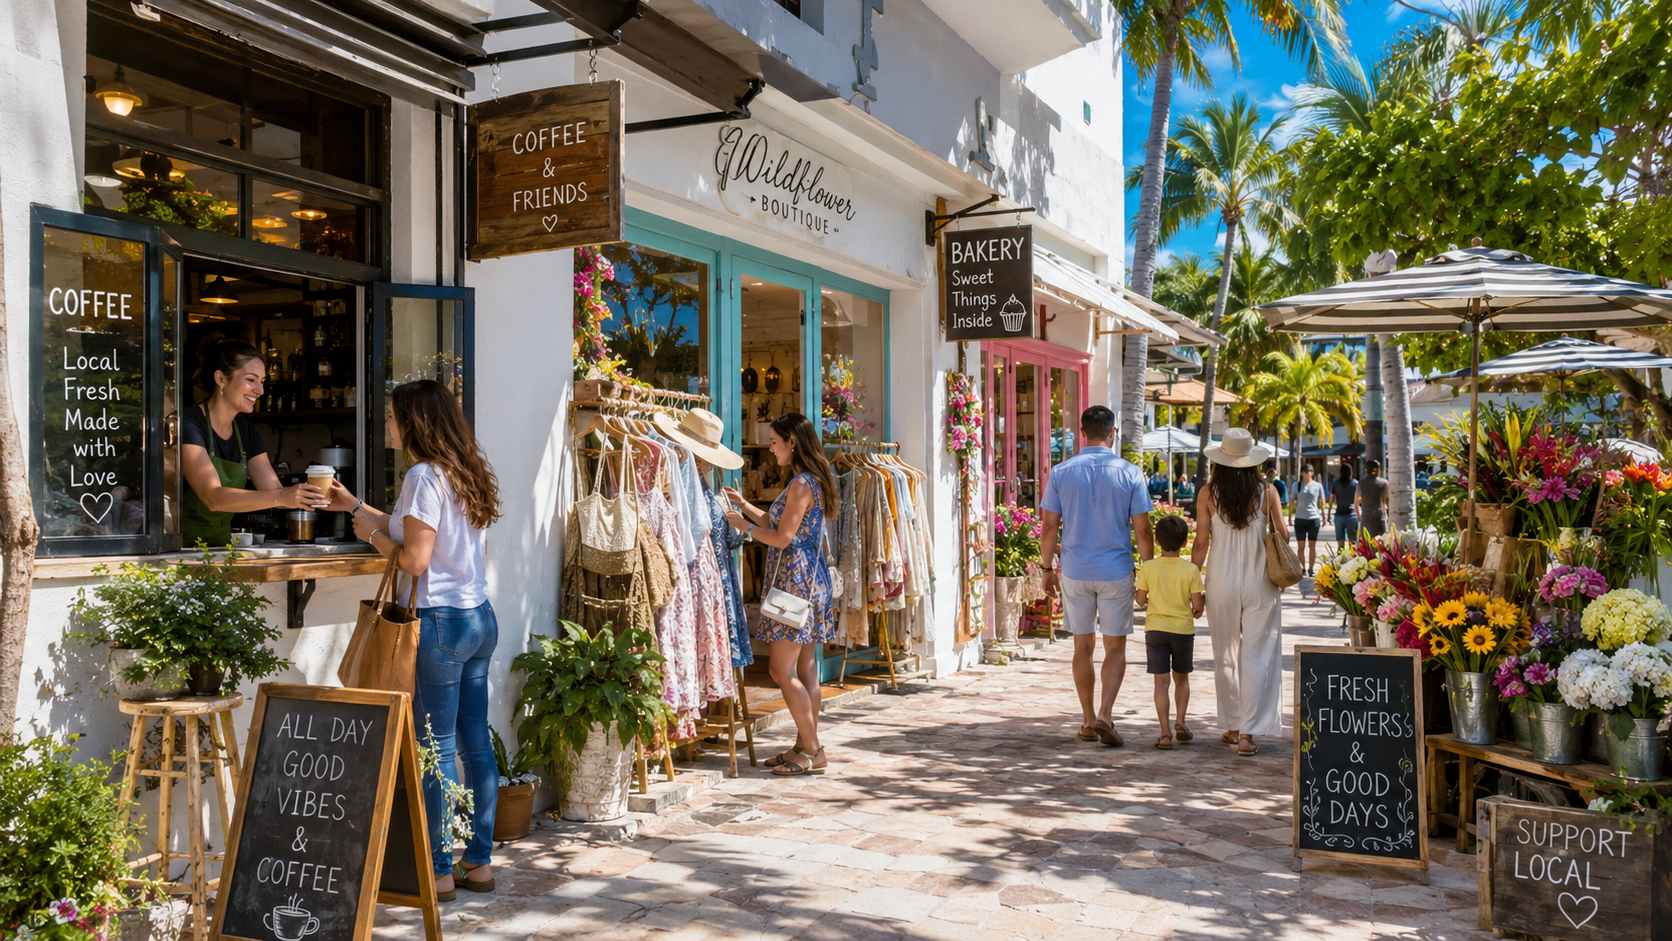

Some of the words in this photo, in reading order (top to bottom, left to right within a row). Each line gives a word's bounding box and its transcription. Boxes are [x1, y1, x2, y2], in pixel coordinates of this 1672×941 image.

[513, 121, 587, 155] COFFEE
[543, 158, 555, 177] &
[715, 127, 856, 221] Wildflower
[514, 182, 587, 211] FRIENDS
[762, 195, 829, 235] BOUTIQUE
[952, 237, 1024, 263] BAKERY
[953, 269, 993, 285] Sweet
[49, 287, 132, 319] COFFEE
[953, 291, 996, 311] Things
[953, 312, 992, 328] Inside
[63, 346, 120, 371] Local
[65, 378, 119, 400] Fresh
[66, 408, 119, 430] Made
[73, 437, 116, 457] with
[71, 465, 117, 486] Love
[1328, 675, 1388, 703] FRESH
[277, 713, 317, 740] ALL
[331, 717, 373, 745] DAY
[1319, 708, 1402, 737] FLOWERS
[284, 751, 344, 780] GOOD
[1350, 742, 1364, 763] &
[1326, 769, 1389, 796] GOOD
[277, 787, 346, 820] VIBES
[1331, 800, 1388, 828] DAYS
[292, 826, 308, 852] &
[1517, 819, 1632, 858] SUPPORT
[257, 857, 341, 893] COFFEE
[1515, 850, 1600, 891] LOCAL
